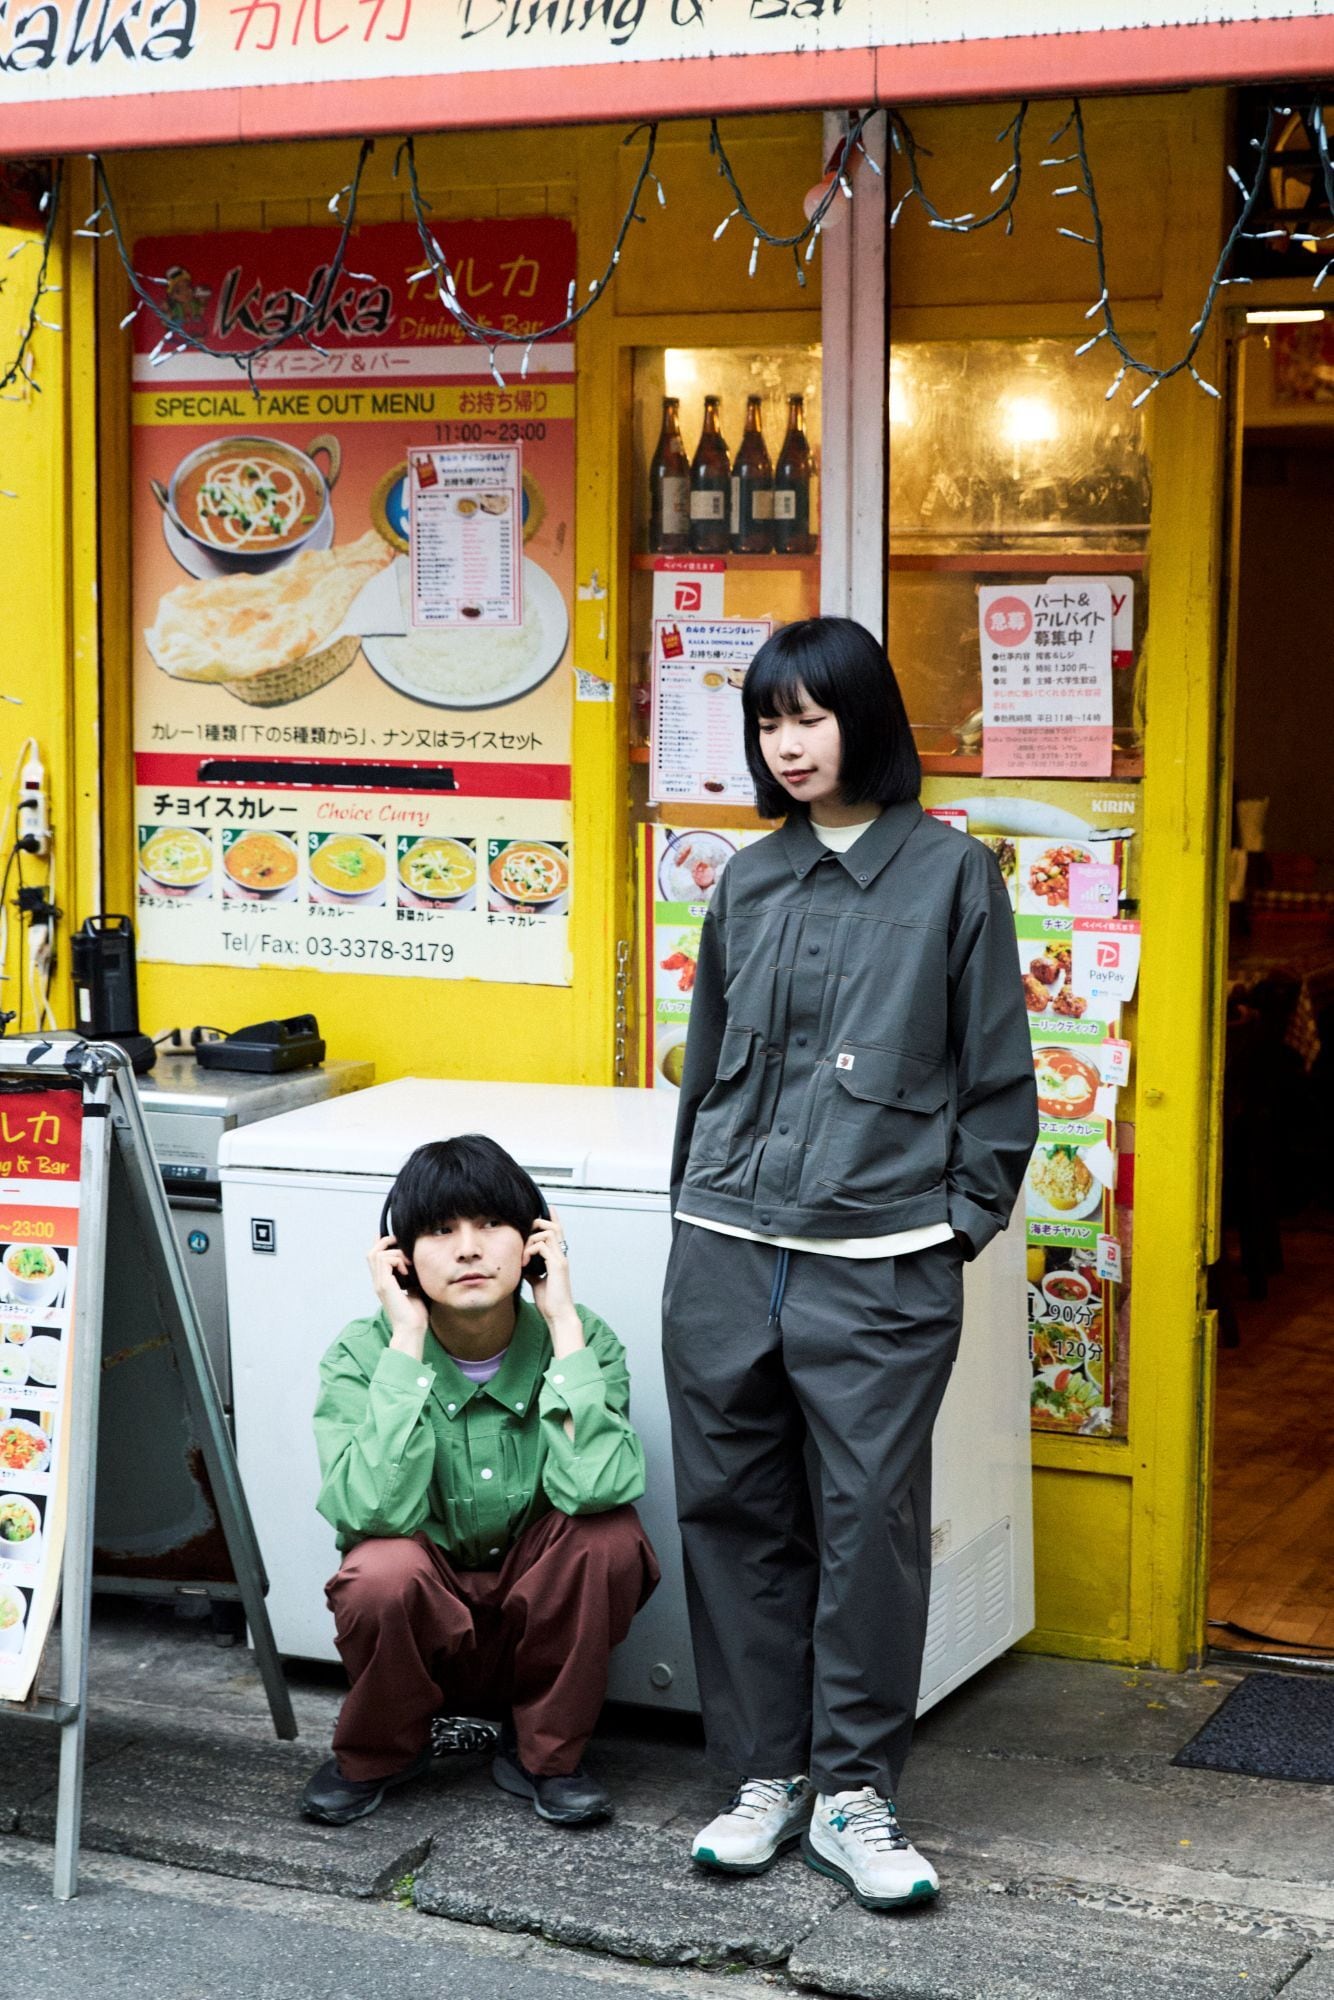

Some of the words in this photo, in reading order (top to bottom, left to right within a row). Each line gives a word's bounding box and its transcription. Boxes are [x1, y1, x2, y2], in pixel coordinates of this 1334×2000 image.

[0, 0, 196, 71] alka
[155, 396, 245, 417] SPECIAL
[254, 395, 310, 416] TAKE
[317, 393, 365, 415] OUT
[371, 391, 435, 414] MENU
[458, 390, 548, 414] お持ち帰り
[1034, 611, 1105, 627] アルバイト
[153, 794, 298, 820] チョイスカレー
[316, 803, 374, 822] Choice
[378, 804, 431, 827] Curry
[1092, 799, 1135, 814] KIRIN
[223, 831, 234, 846] 2
[309, 834, 320, 849] 3
[398, 837, 409, 853] 4
[489, 841, 499, 857] 5
[396, 909, 445, 922] 野菜カレー
[487, 915, 547, 927] キーマカレー
[221, 932, 299, 956] Tel/Fax:
[306, 936, 454, 962] 03-3378-3179
[1089, 968, 1125, 984] PayPay
[35, 1155, 70, 1174] Bar
[1050, 1304, 1093, 1326] 90分
[1056, 1341, 1103, 1361] 120分
